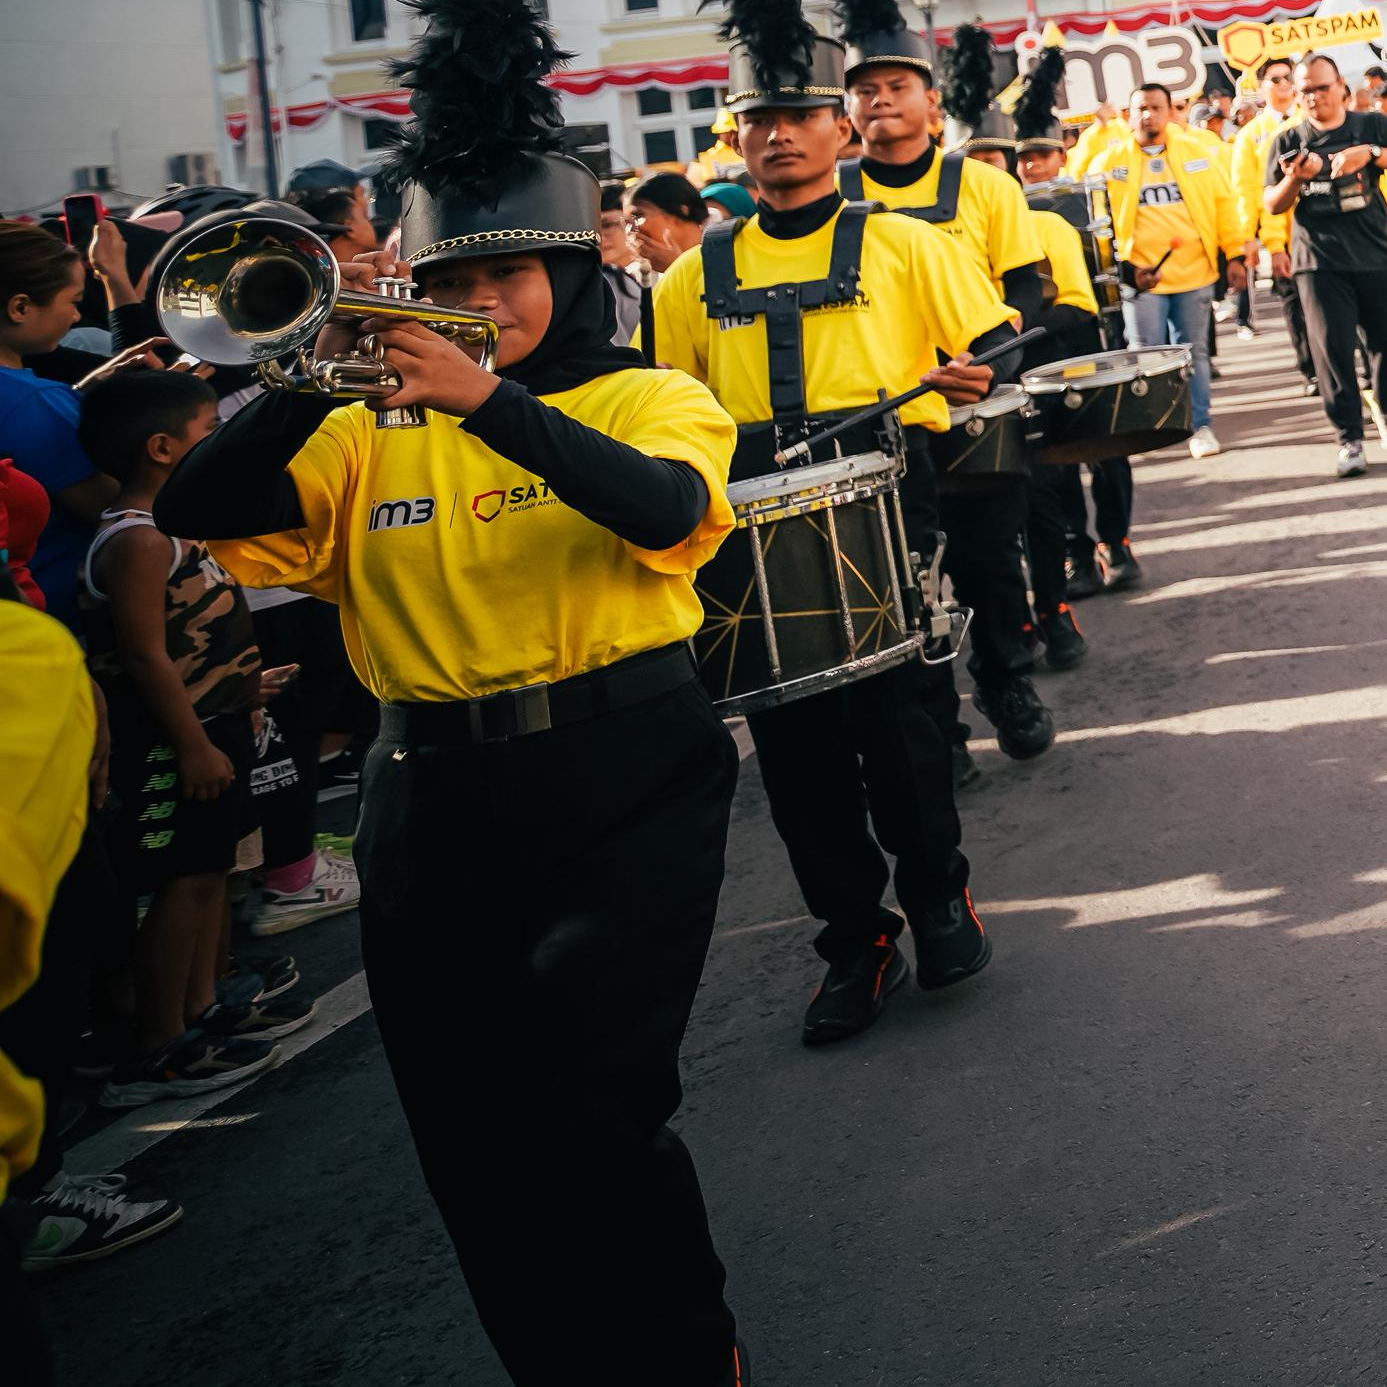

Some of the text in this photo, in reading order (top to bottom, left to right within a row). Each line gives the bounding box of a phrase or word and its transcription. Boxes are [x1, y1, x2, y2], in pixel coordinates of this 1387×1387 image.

[1271, 12, 1380, 45] SATSPAM
[367, 499, 435, 532] im3
[508, 499, 558, 513] SATUAN ANTI
